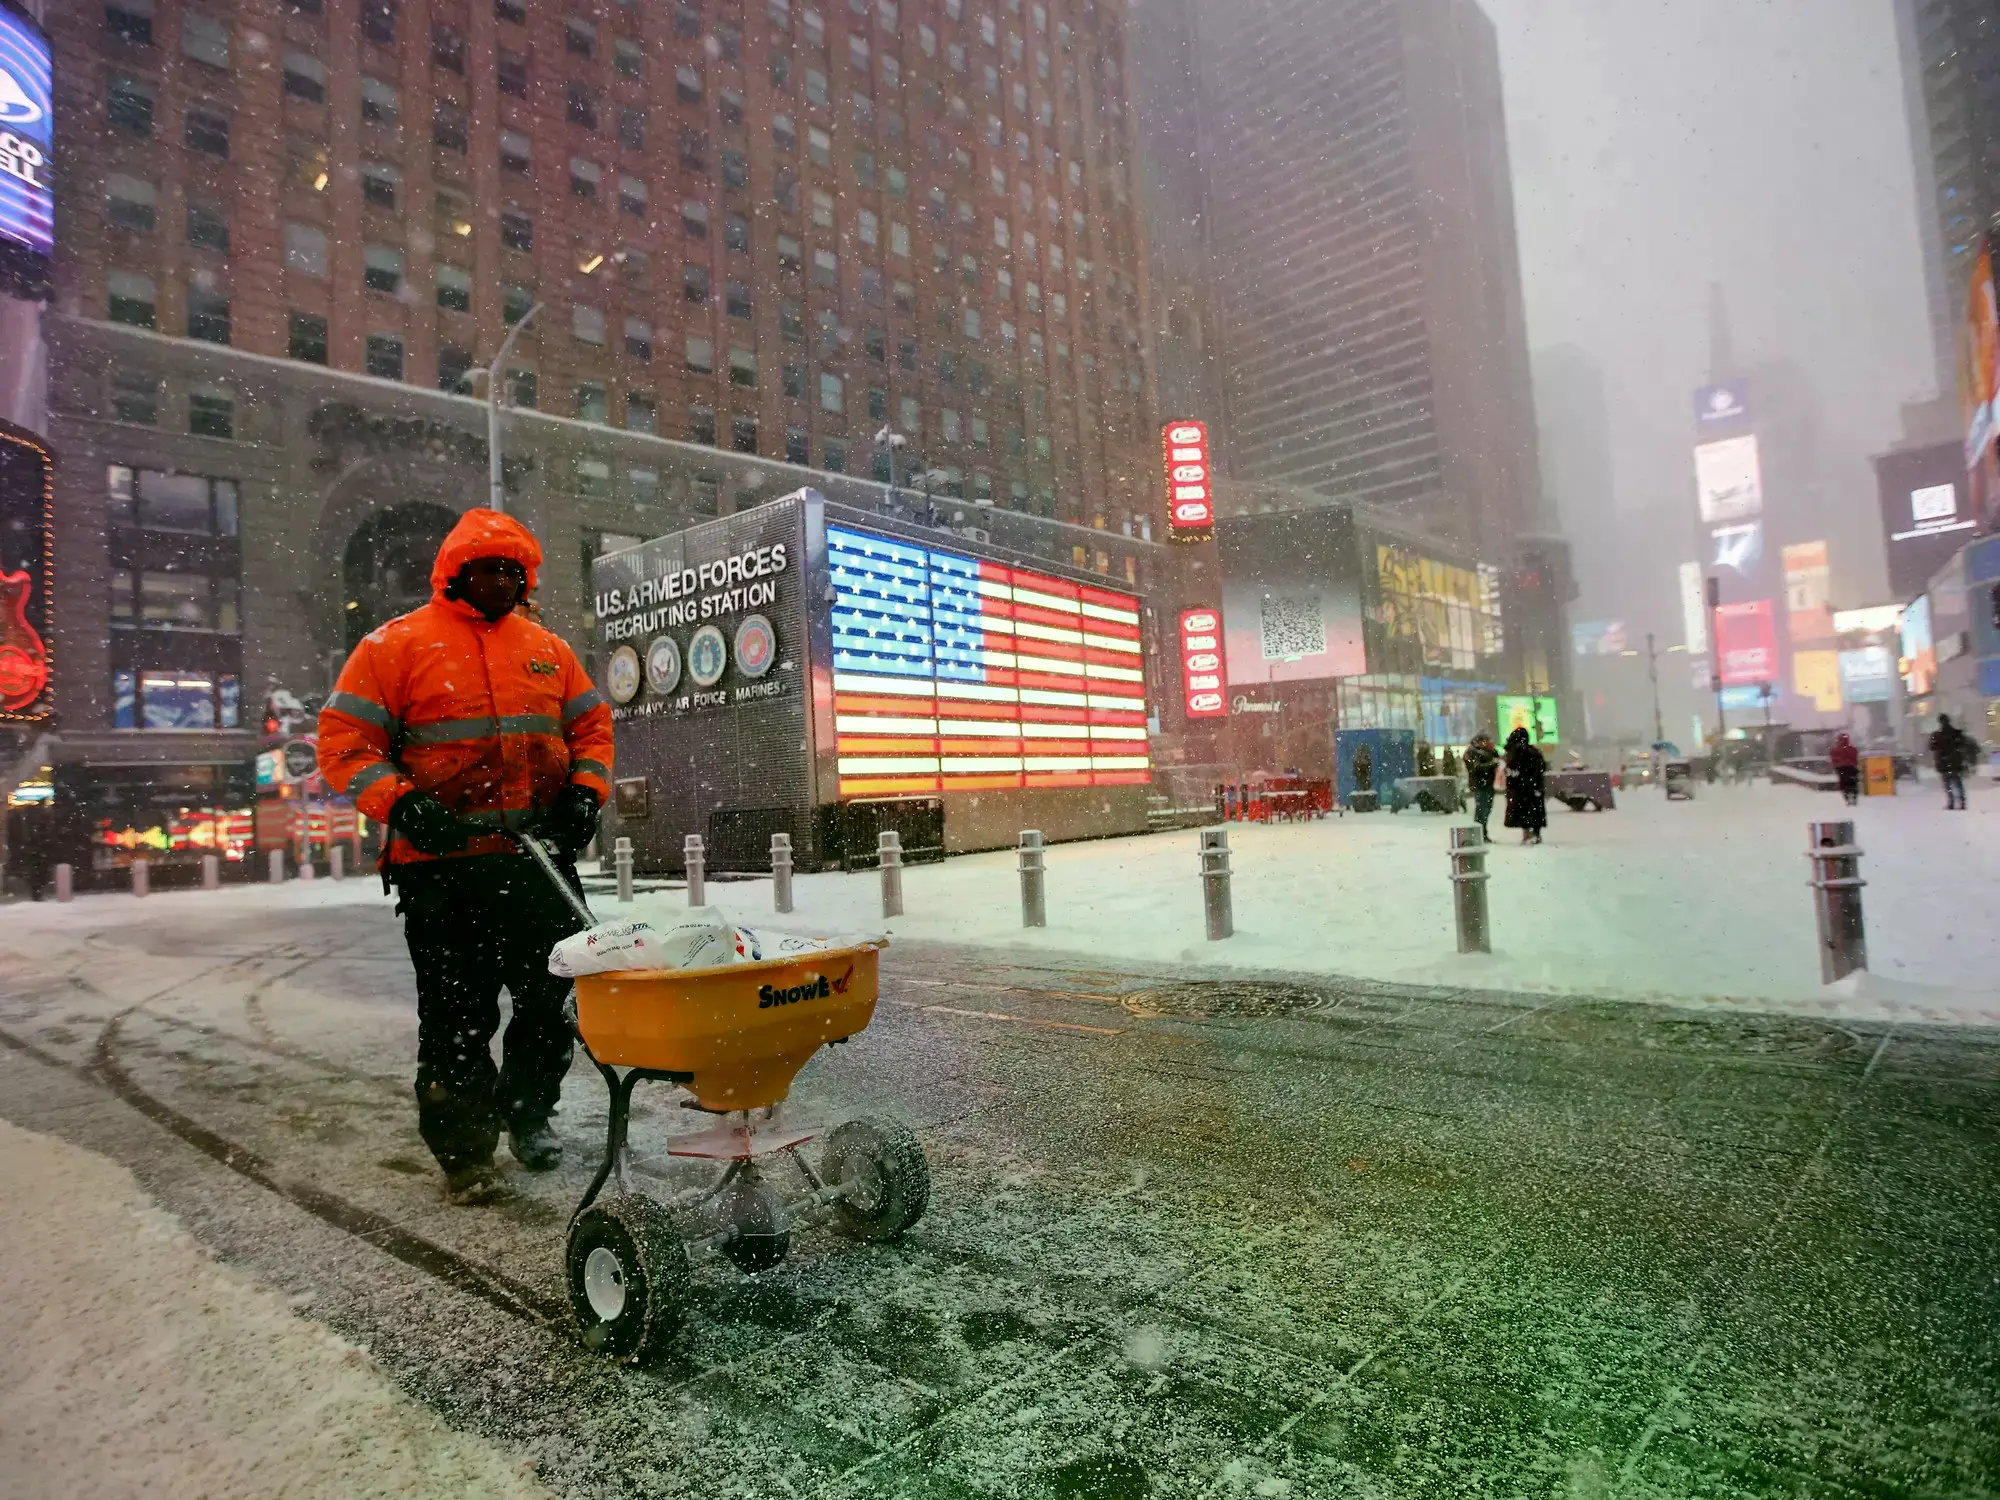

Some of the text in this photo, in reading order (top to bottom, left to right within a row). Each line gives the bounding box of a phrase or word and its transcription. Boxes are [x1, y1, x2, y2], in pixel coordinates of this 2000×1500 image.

[595, 543, 788, 619] U.S. ARMED FORCES
[605, 580, 776, 642] RECRUITING STATION
[638, 700, 664, 716] NAVY
[693, 690, 727, 708] FORCE
[736, 681, 781, 700] MARINES
